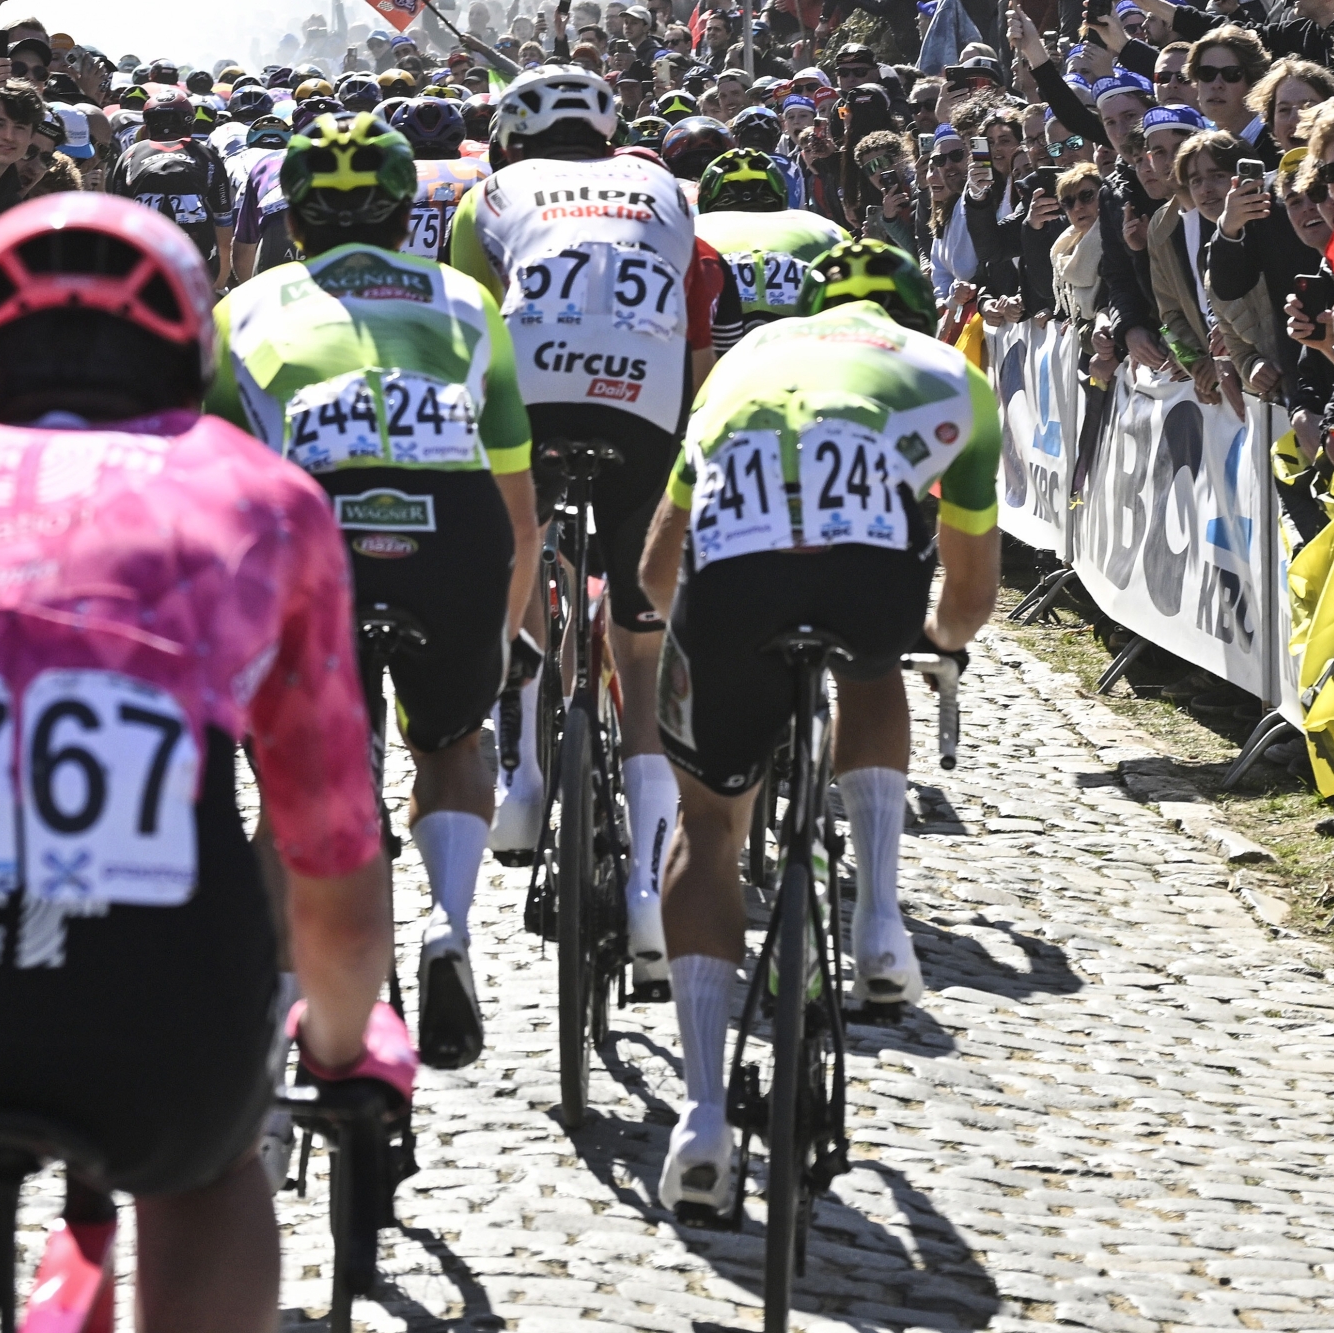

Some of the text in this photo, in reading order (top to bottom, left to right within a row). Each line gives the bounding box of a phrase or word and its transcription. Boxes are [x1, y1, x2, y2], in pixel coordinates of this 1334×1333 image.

[615, 257, 675, 314] 57
[765, 257, 808, 291] 24
[534, 340, 647, 381] Circus
[384, 382, 474, 436] 244
[594, 381, 635, 401] Daily
[816, 439, 893, 514] 241
[1029, 461, 1060, 529] KBC
[1196, 560, 1255, 654] KBC
[31, 699, 183, 837] 67
